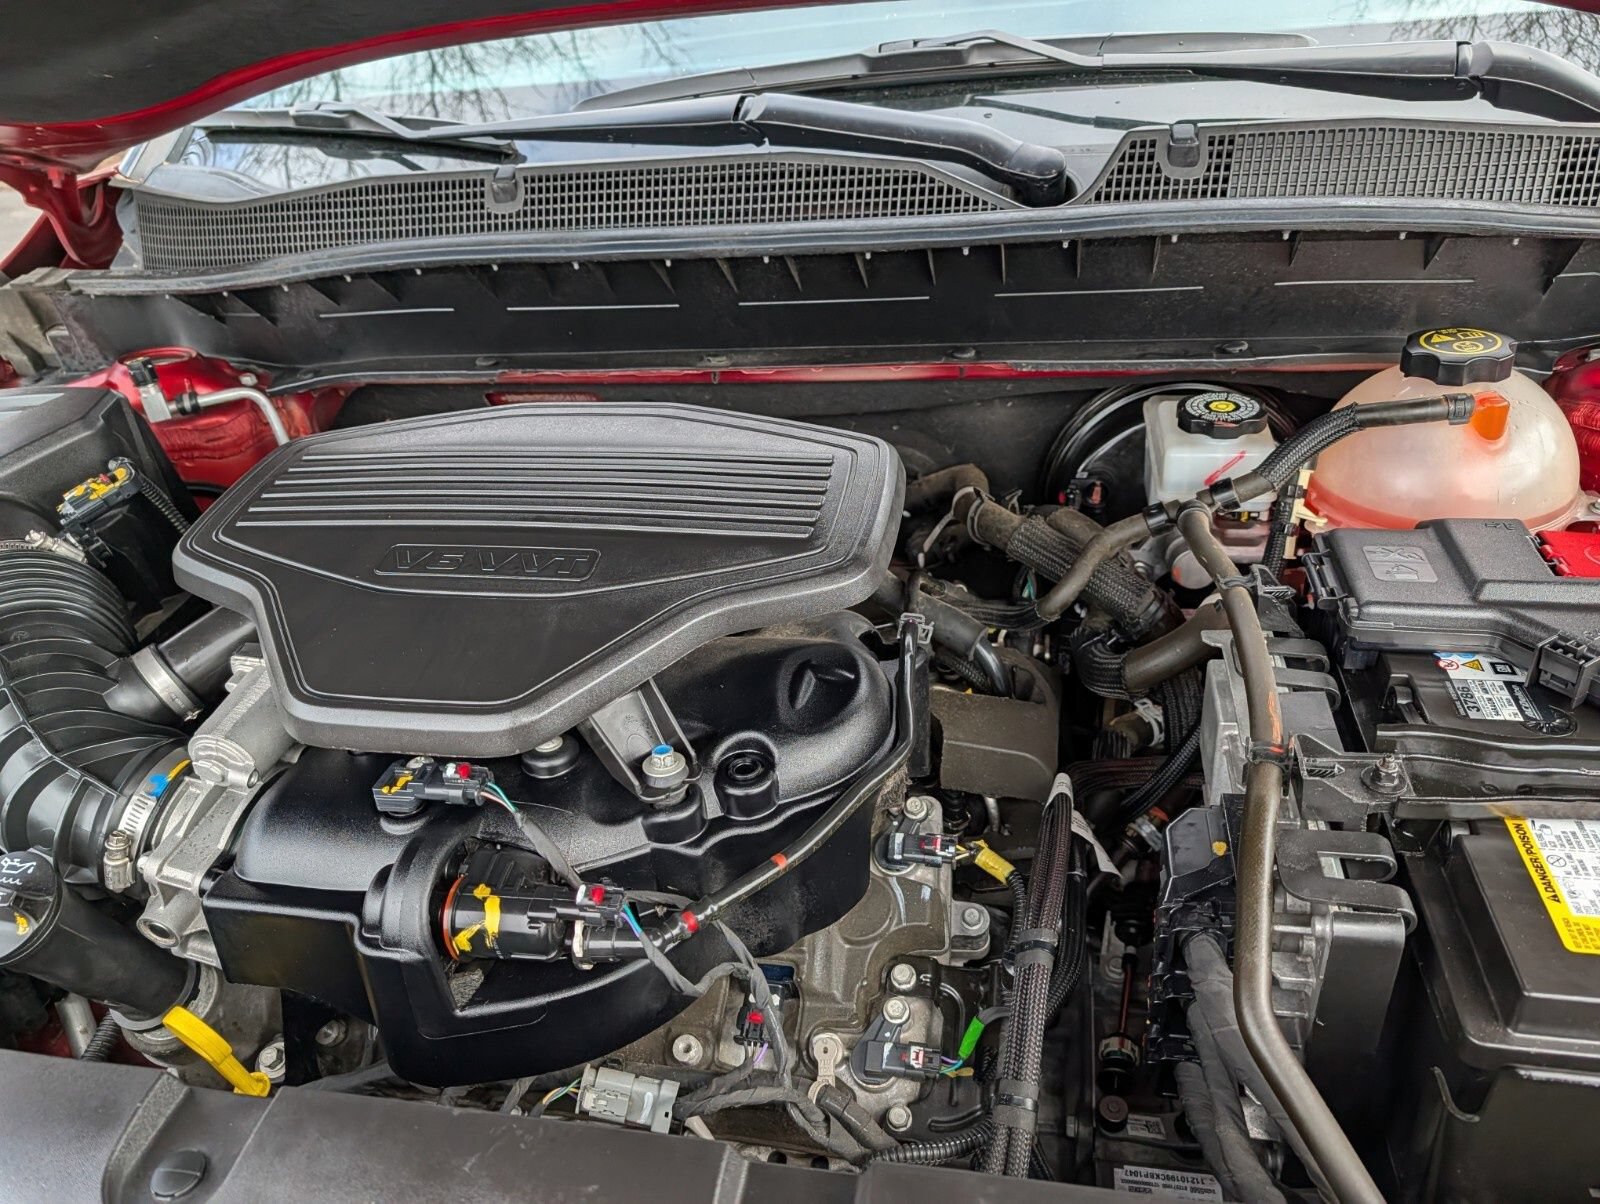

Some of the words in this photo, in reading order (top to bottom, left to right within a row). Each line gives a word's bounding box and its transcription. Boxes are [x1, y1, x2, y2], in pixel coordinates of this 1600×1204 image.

[396, 549, 465, 570] V6
[477, 550, 590, 575] VVT
[1457, 686, 1481, 713] 3786
[1512, 822, 1556, 893] DANGER/POISON
